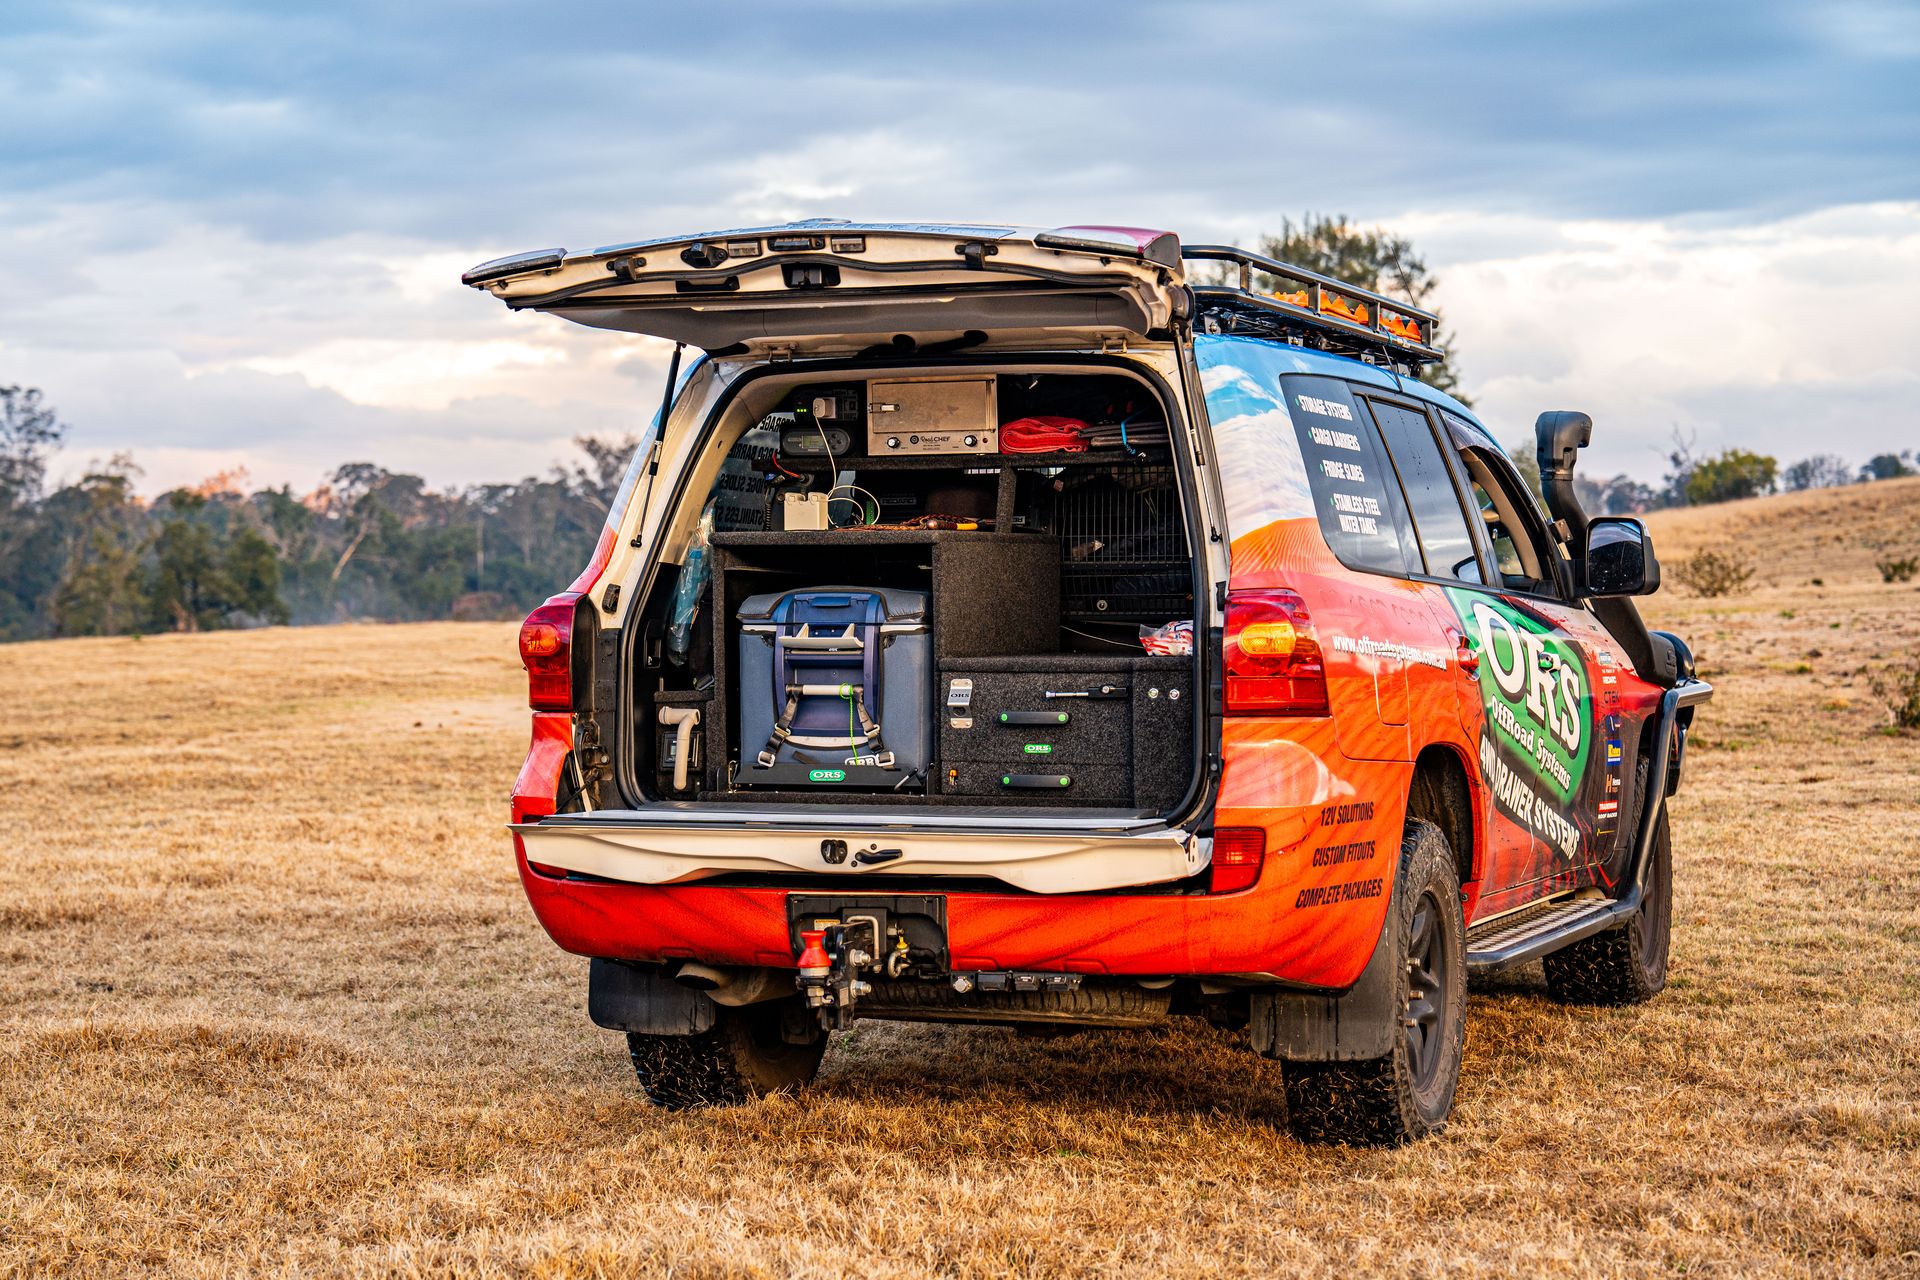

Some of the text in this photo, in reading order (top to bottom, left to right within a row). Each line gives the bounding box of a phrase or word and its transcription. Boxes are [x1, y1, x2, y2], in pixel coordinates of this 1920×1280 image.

[1298, 394, 1353, 421] STORAGE SYSTEMS
[1311, 426, 1361, 451] CARGO BARRIERS
[1322, 459, 1365, 482] FRIDGE SLIDES
[1333, 492, 1382, 516] STAINLESS STEEL
[1338, 514, 1378, 535] WATER TANKS
[1472, 601, 1580, 752] ORS
[1491, 694, 1571, 791] OffRoad Systems
[813, 771, 841, 779] ORS
[1480, 734, 1580, 860] 4WD DRAWER SYSTEMS
[1320, 801, 1374, 827] 12V SOLUTIONS
[1312, 840, 1376, 868] CUSTOM FITOUTS
[1295, 878, 1383, 909] COMPLETE PACKAGES
